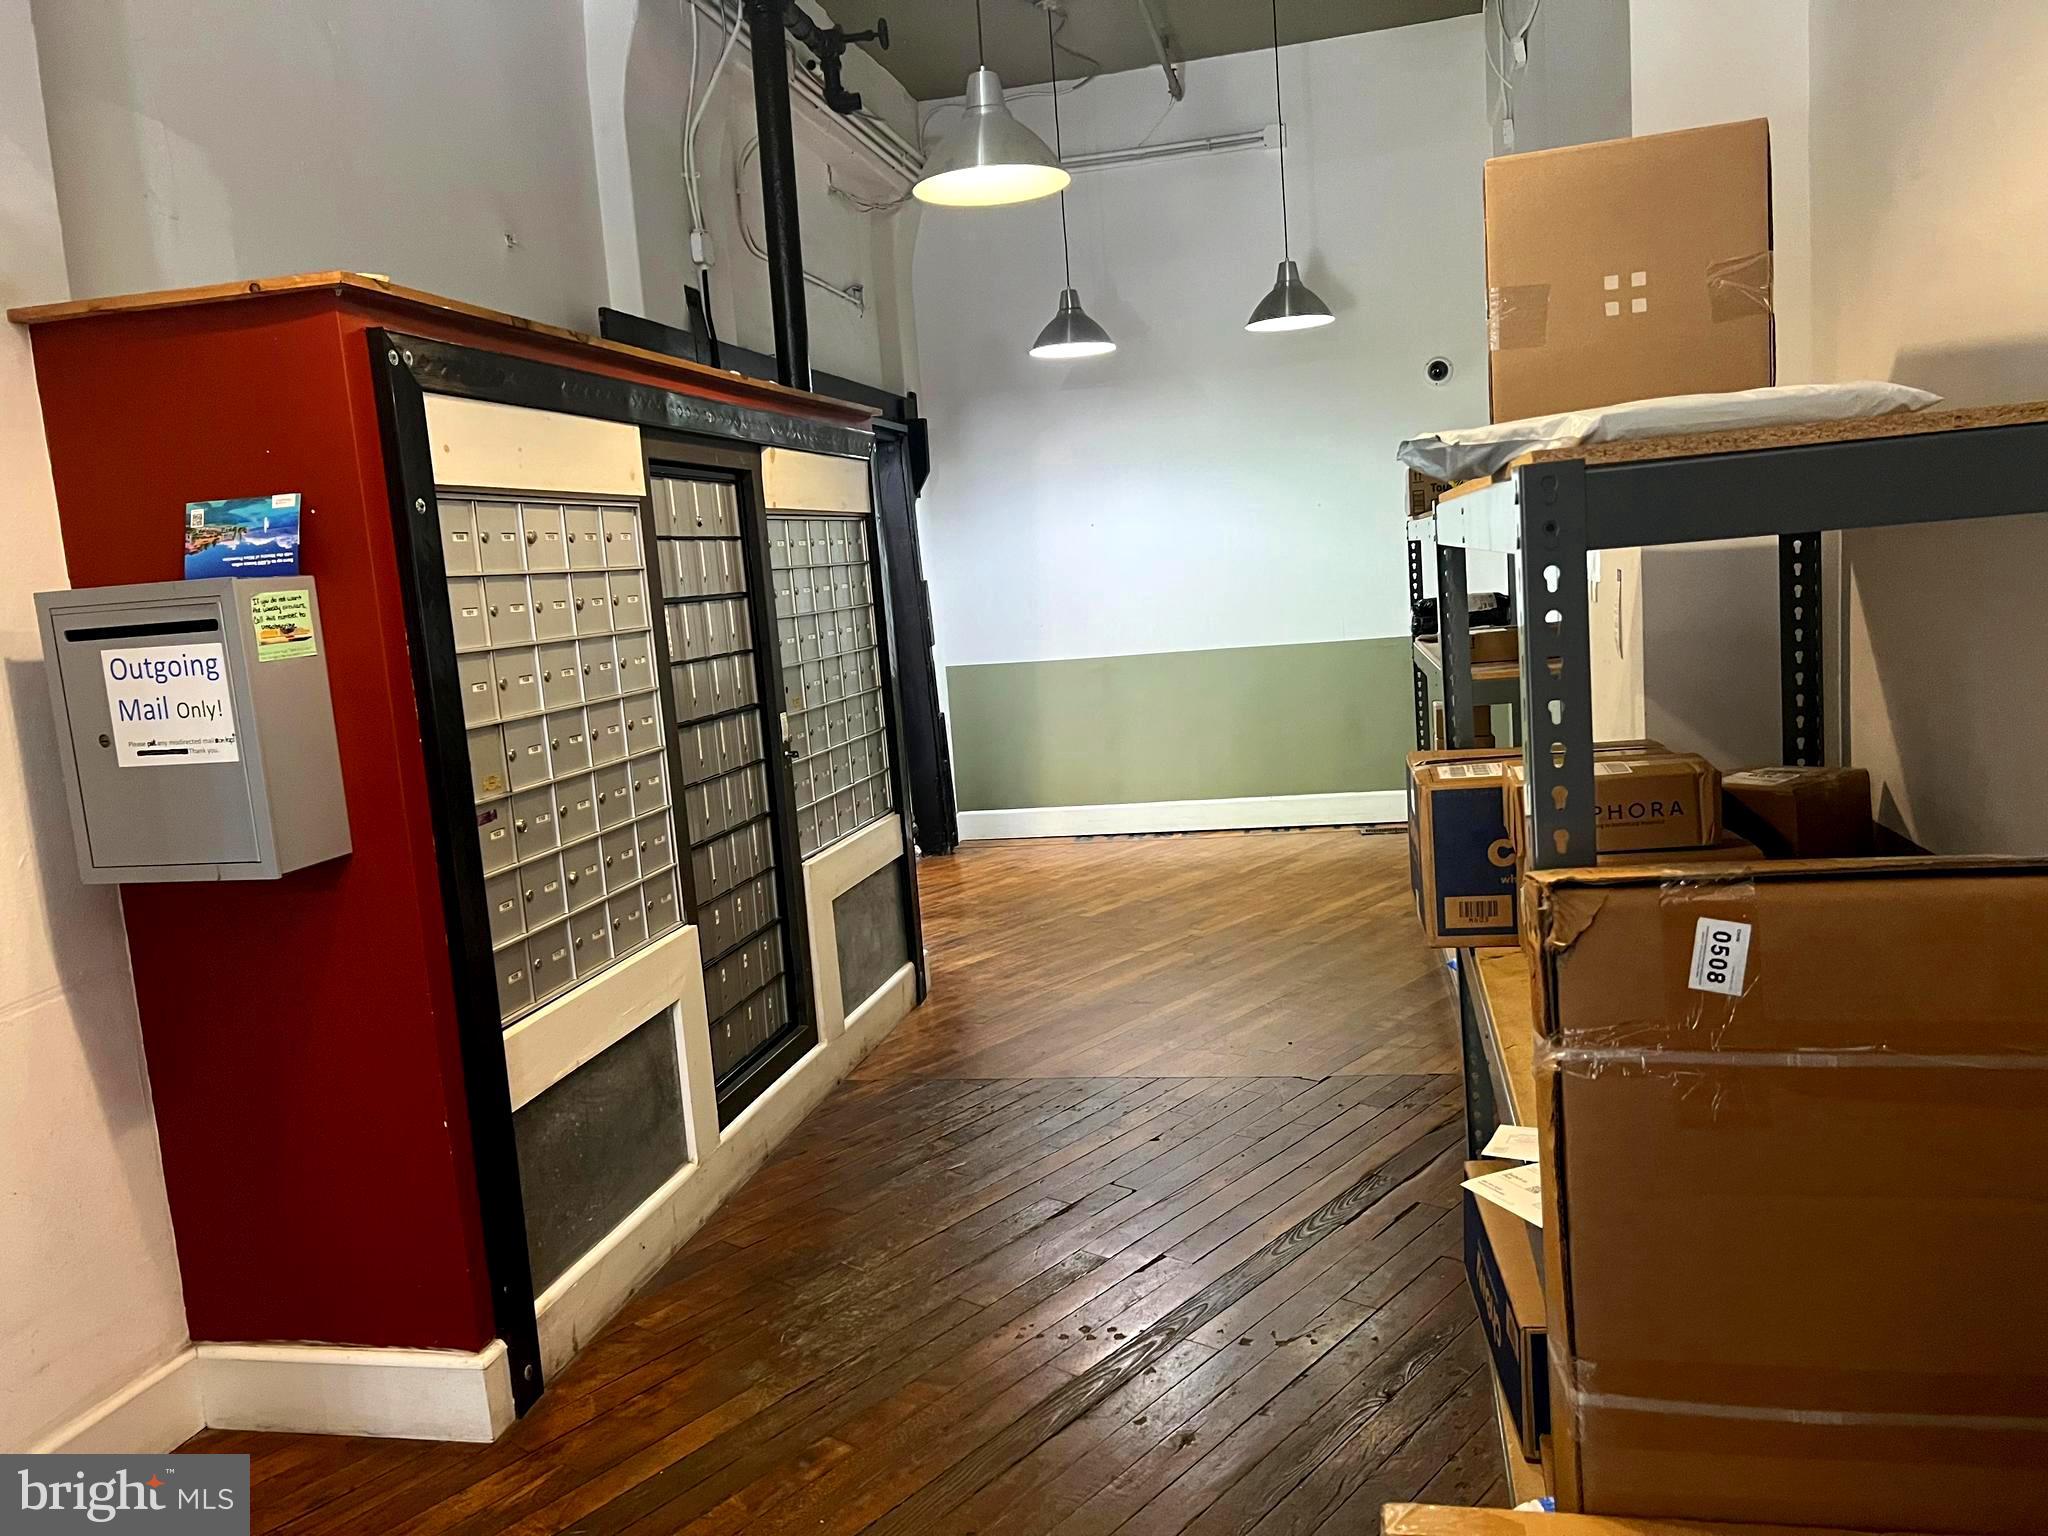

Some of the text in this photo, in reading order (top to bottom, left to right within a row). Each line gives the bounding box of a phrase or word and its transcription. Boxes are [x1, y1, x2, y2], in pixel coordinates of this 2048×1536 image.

[110, 653, 220, 684] Outgoing
[119, 695, 223, 722] Mail Only!
[1706, 931, 1732, 983] 0508
